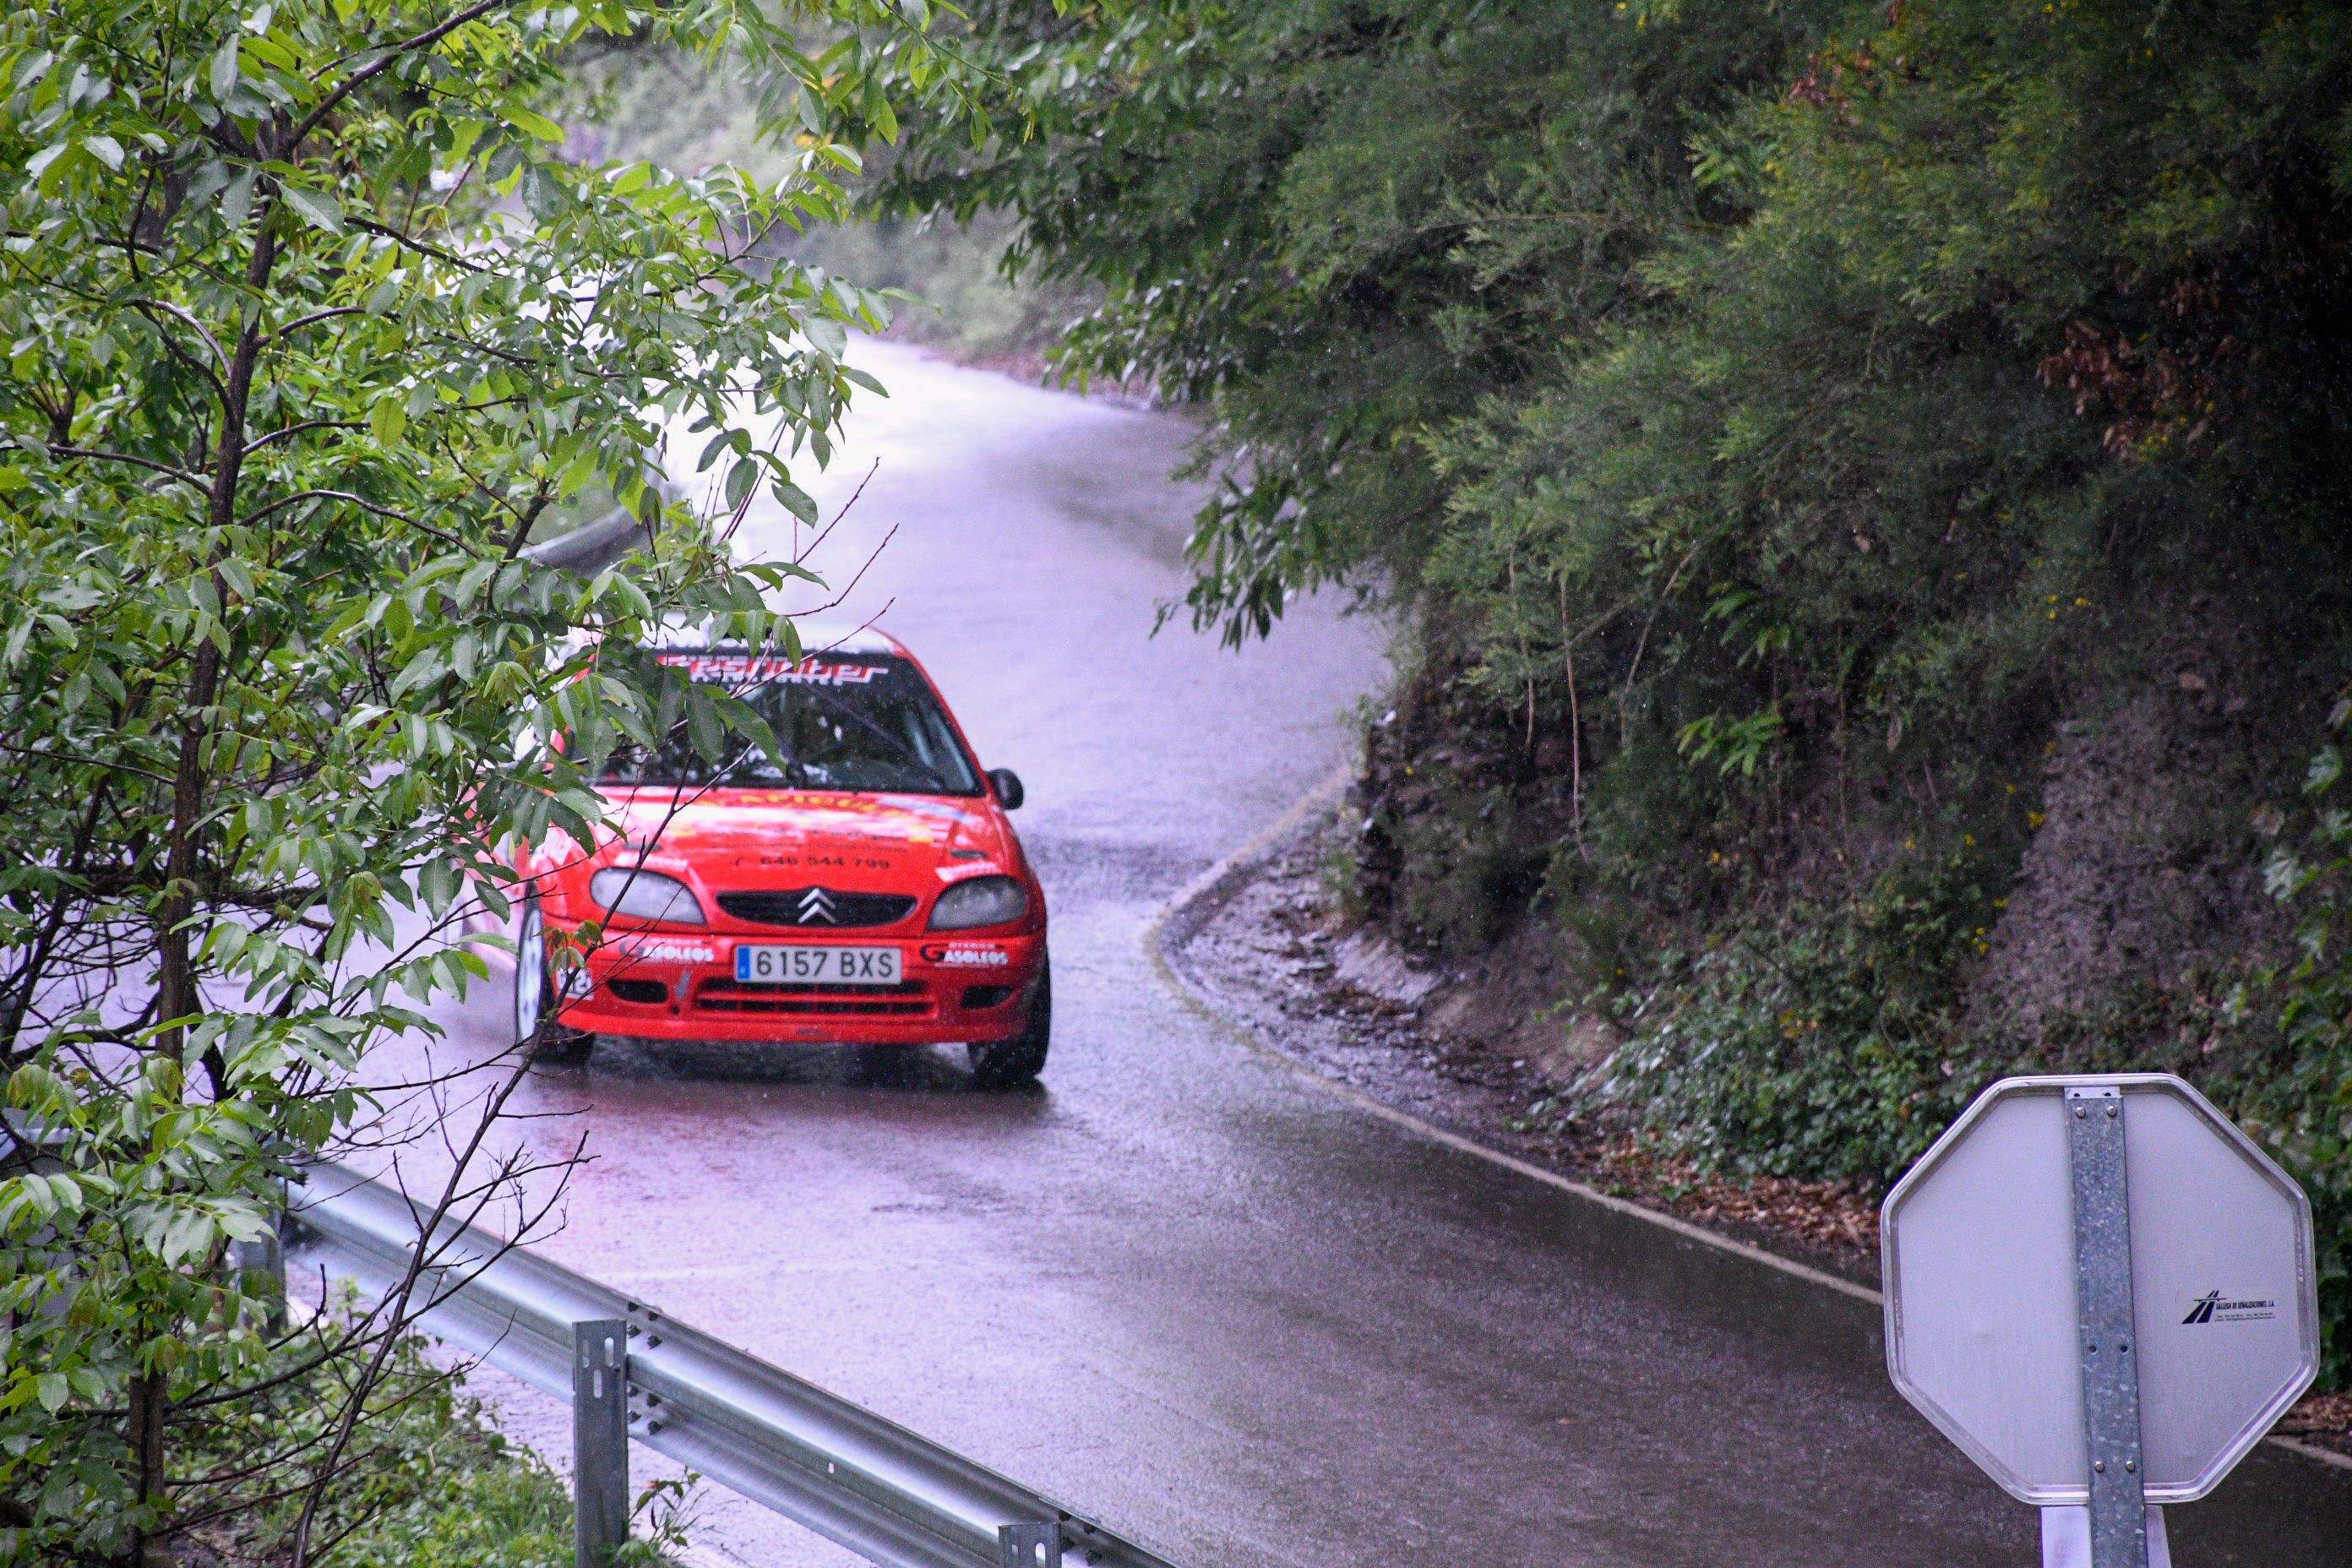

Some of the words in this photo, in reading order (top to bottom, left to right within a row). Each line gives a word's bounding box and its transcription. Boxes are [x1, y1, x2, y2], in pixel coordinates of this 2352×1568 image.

[757, 950, 828, 977] 6157
[841, 951, 893, 978] BXS
[921, 944, 1009, 965] GASOLEOS
